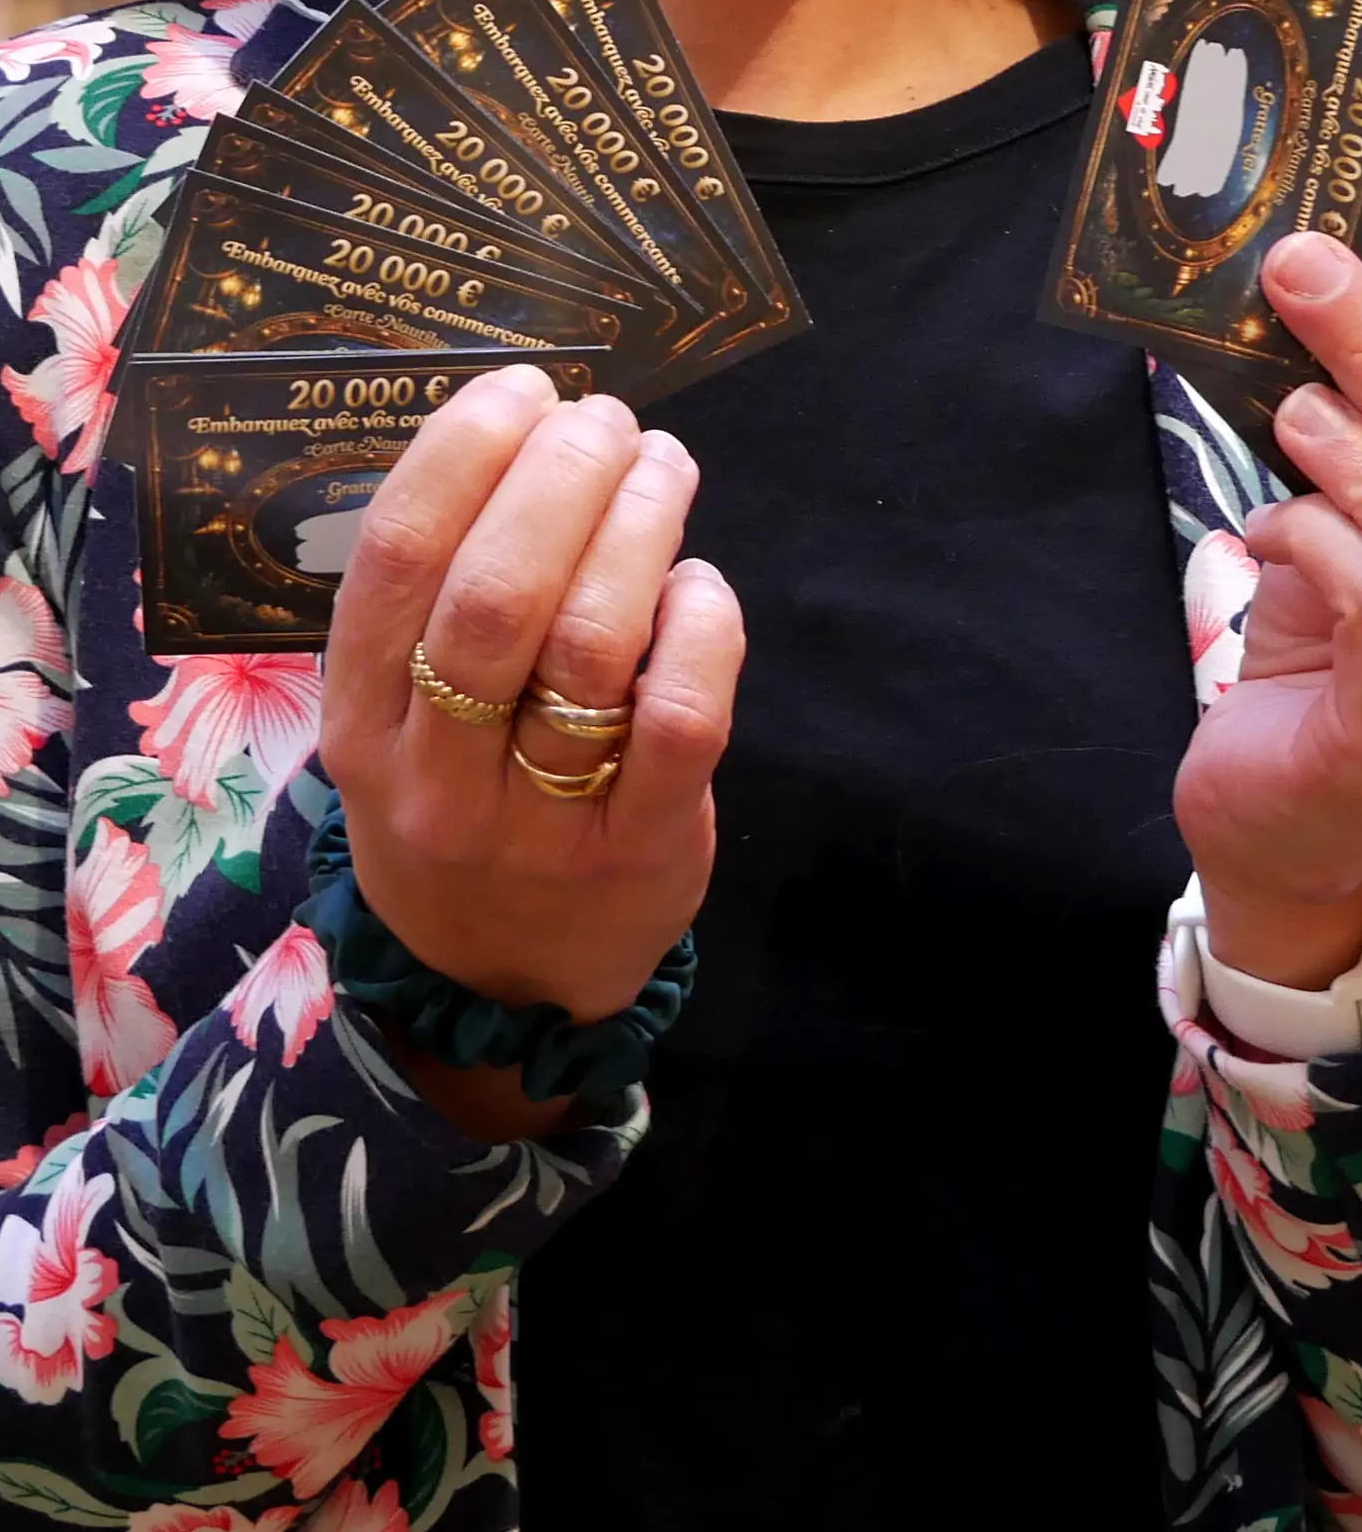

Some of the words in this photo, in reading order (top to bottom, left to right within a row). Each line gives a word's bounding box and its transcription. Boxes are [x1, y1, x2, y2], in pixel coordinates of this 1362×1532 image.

[473, 3, 550, 118] Embarquez
[350, 75, 445, 176] Embarquez
[632, 54, 675, 98] 20
[659, 103, 709, 168] 000
[694, 175, 725, 201] €
[1300, 79, 1318, 130] Carte
[545, 67, 592, 110] 20
[581, 112, 639, 175] 000
[630, 177, 661, 203] €
[435, 120, 485, 162] 20
[480, 158, 544, 215] 000
[542, 213, 571, 239] €
[345, 193, 396, 228] 20
[398, 214, 469, 253] 000
[1318, 211, 1348, 238] €
[221, 240, 346, 299] Embarquez
[322, 238, 375, 274] 20
[379, 254, 451, 298] 000
[456, 279, 486, 308] €
[323, 303, 375, 326] Carte
[287, 379, 336, 410] 20
[344, 376, 415, 408] 000
[424, 375, 451, 406] €
[188, 417, 322, 438] Embarquez
[303, 440, 356, 457] Carte
